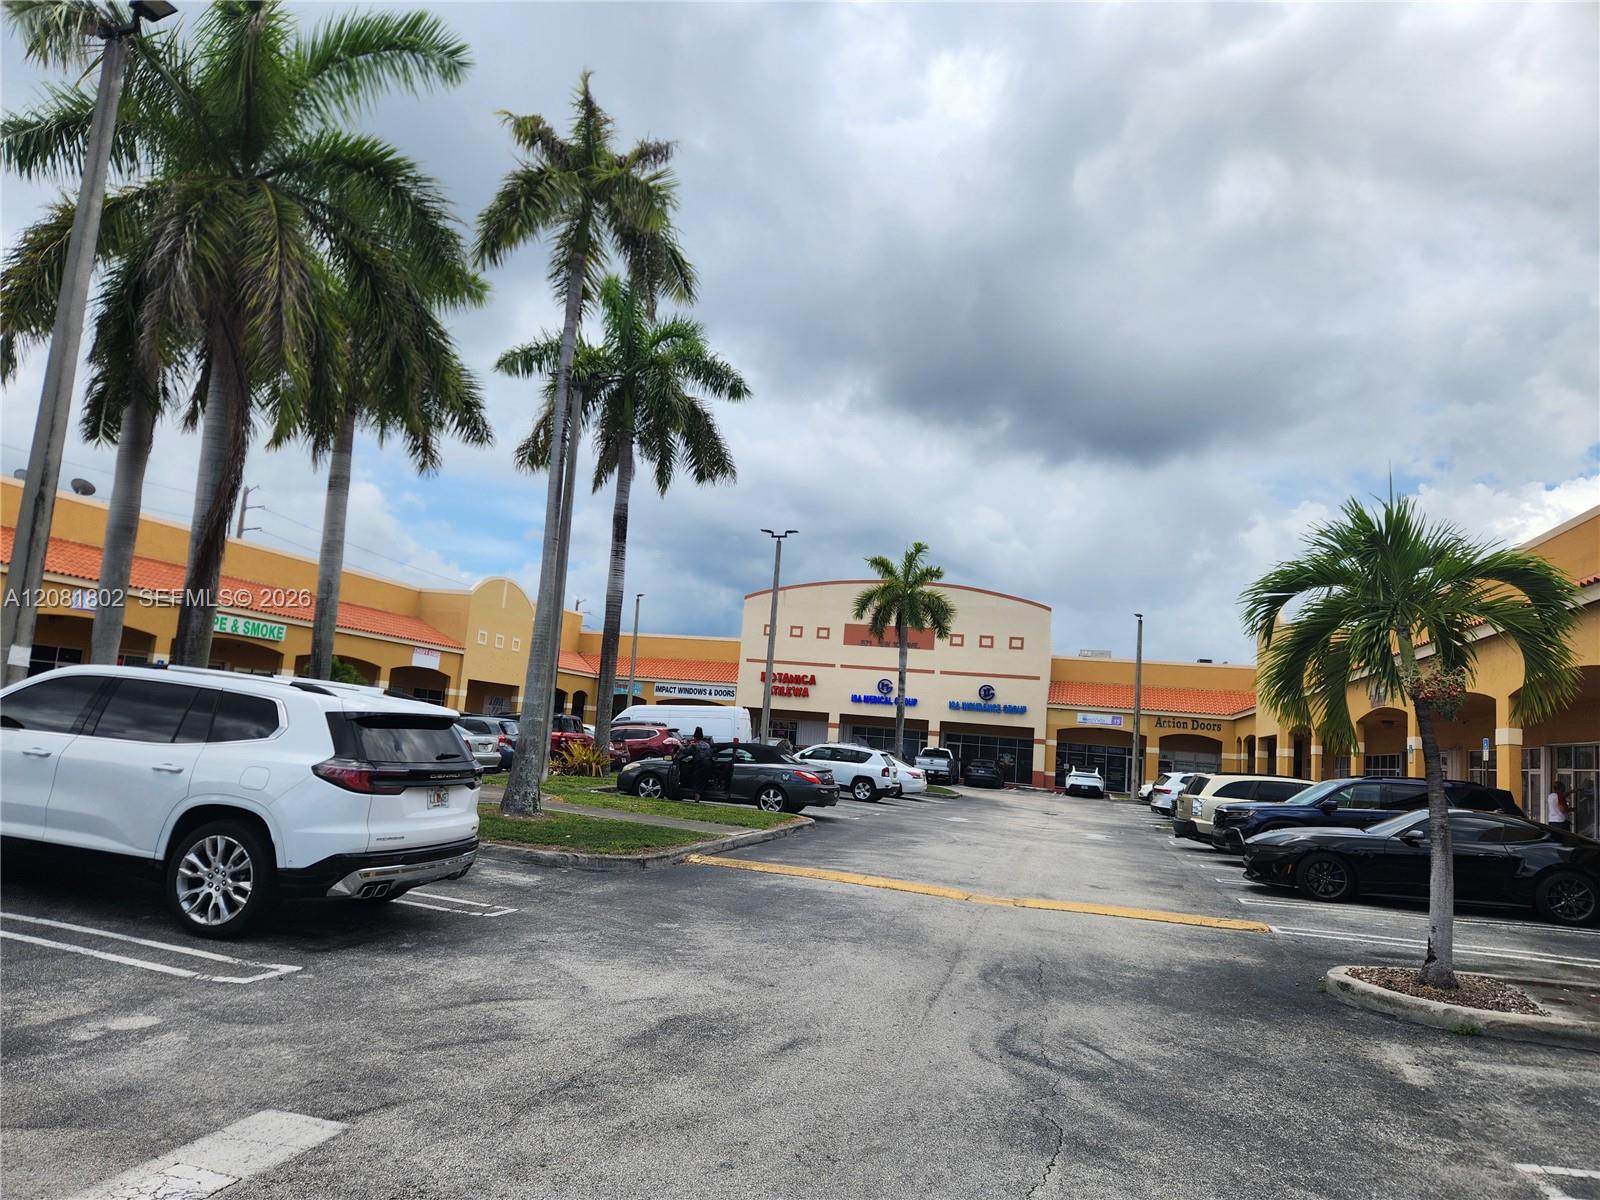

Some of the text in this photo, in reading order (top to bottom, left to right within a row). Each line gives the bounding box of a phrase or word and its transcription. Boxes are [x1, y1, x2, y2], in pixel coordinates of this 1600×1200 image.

[231, 620, 240, 633] &
[242, 620, 285, 640] SMOKE
[655, 685, 735, 697] IMPACT WINDOWS & DOORS
[863, 695, 893, 705] MEDICAL
[894, 696, 918, 707] GOUP
[962, 701, 1002, 713] INSURANCE
[1002, 704, 1027, 715] GROUP
[1154, 717, 1222, 732] Action Doors
